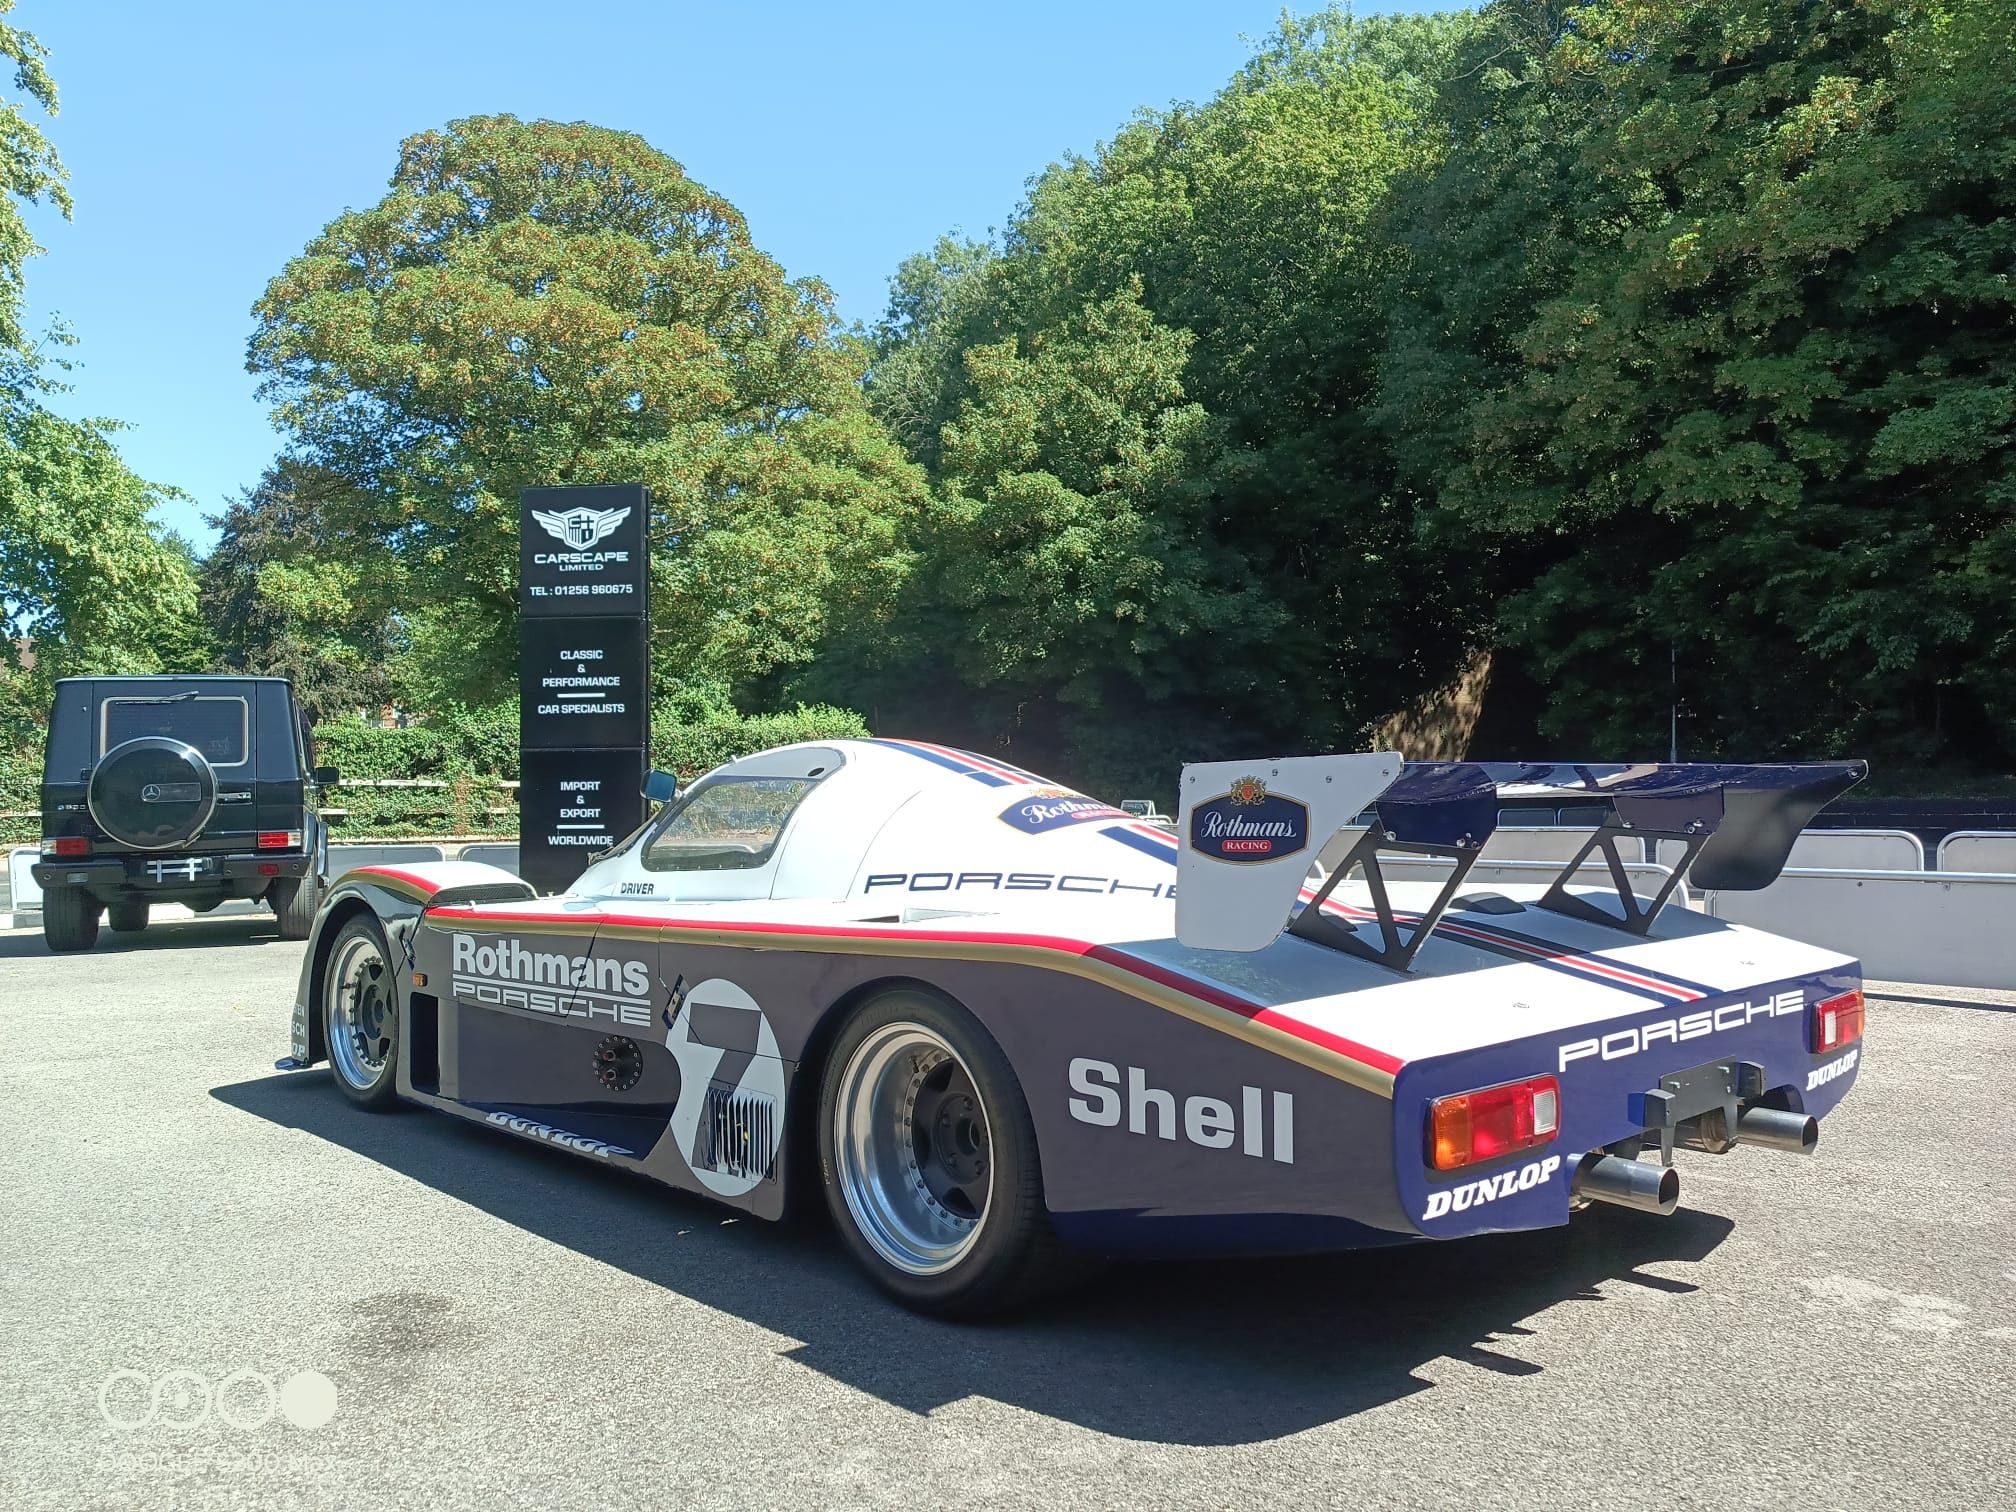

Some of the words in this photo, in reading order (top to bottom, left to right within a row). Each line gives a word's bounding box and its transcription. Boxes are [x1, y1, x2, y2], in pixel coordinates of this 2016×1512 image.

[534, 552, 629, 564] CARSCAPE
[559, 563, 604, 571] LIMITED
[554, 585, 590, 595] 01256
[591, 584, 633, 595] 960675
[560, 650, 603, 660] CLASSIC
[577, 664, 586, 673] &
[542, 676, 620, 687] PERFORMANCE
[537, 704, 560, 714] CAR
[561, 703, 625, 714] SPECIALISTS
[560, 781, 601, 791] IMPORT
[576, 795, 585, 804] &
[559, 808, 601, 818] EXPORT
[1200, 811, 1297, 838] Rothmans
[548, 835, 614, 846] WORLDWIDE
[1226, 841, 1268, 850] RACING
[620, 882, 655, 895] DRIVER
[452, 933, 650, 996] Rothmans
[452, 981, 651, 1028] PORSCHE
[1559, 989, 1805, 1073] PORSCHE
[1805, 1048, 1858, 1092] DUNLOP
[1068, 1057, 1294, 1164] Shell
[485, 1111, 635, 1158] DUNLOP
[1421, 1155, 1561, 1221] DUNLOP
